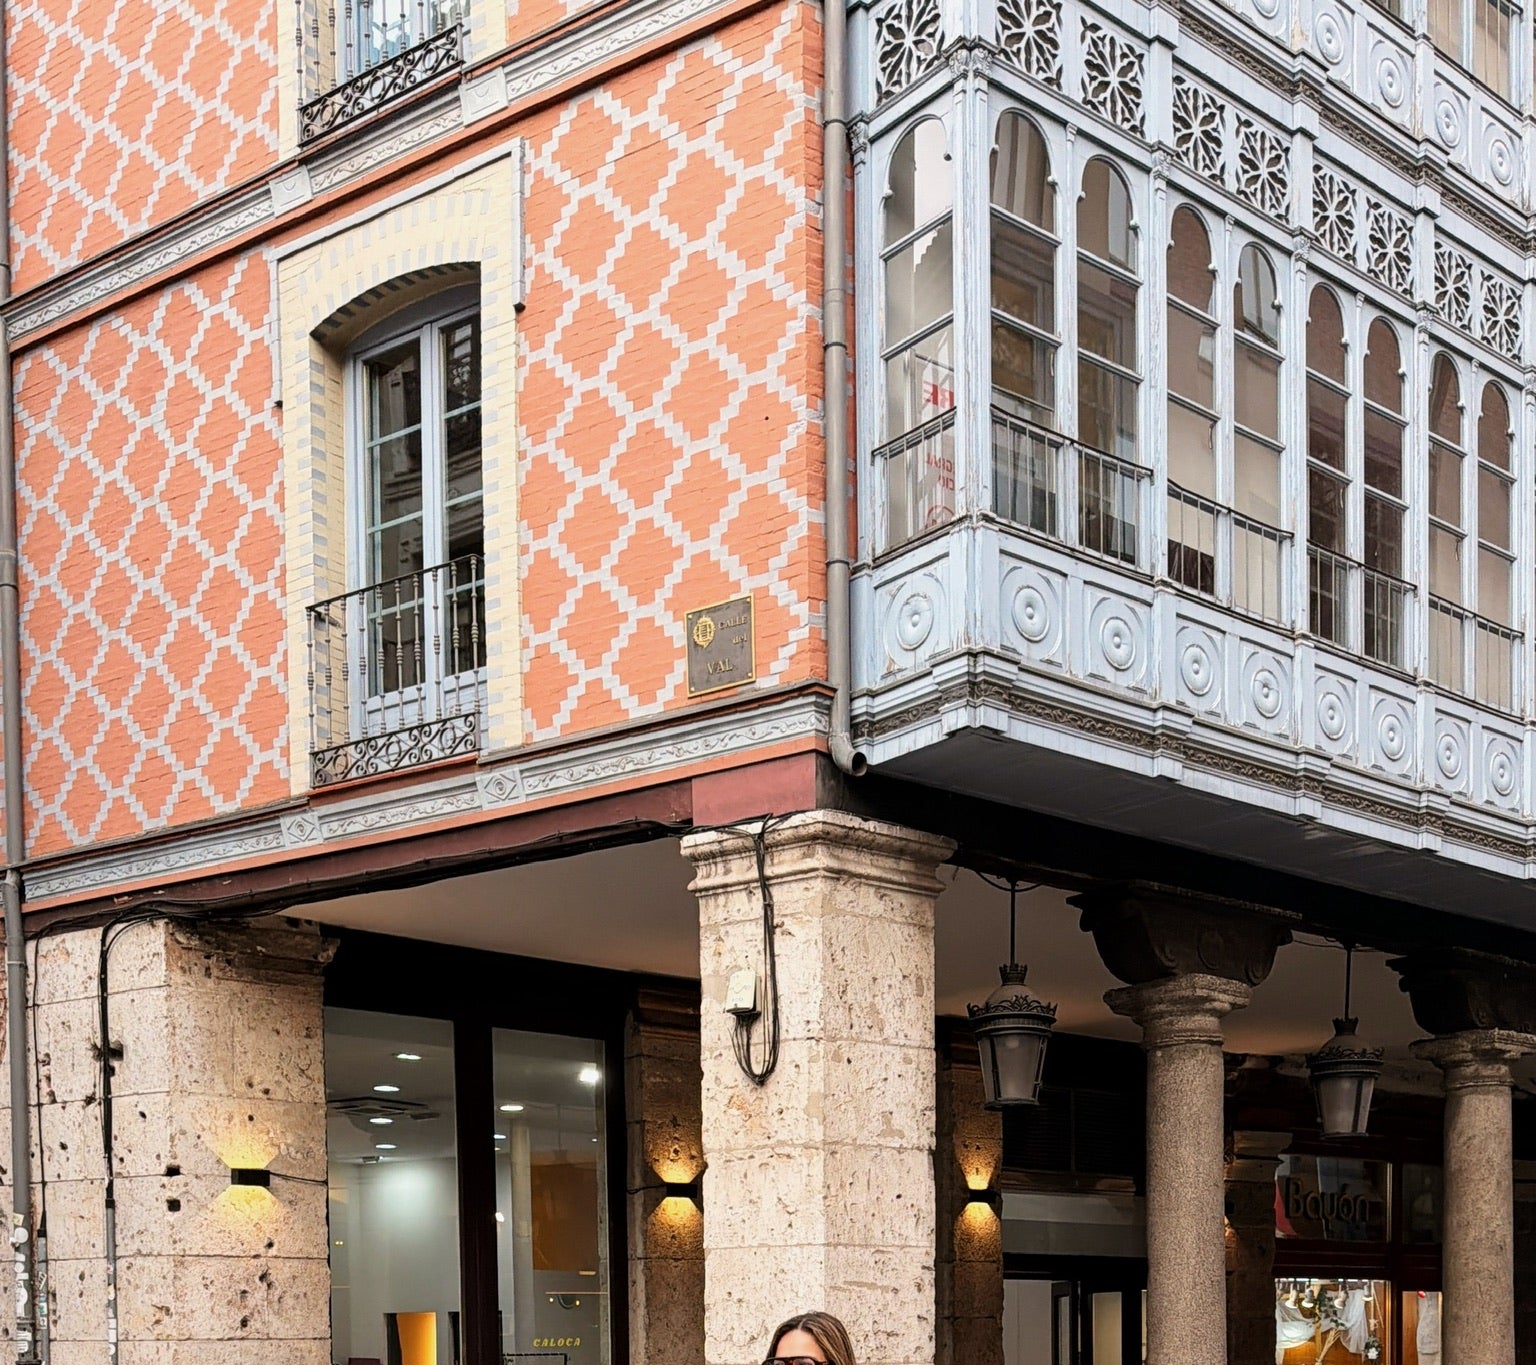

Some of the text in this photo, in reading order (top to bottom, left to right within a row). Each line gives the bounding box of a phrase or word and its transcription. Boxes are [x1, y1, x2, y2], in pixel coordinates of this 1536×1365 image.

[717, 615, 747, 630] CALLE
[732, 633, 747, 645] del
[707, 658, 733, 674] VAL
[532, 1337, 581, 1348] CALOCA
